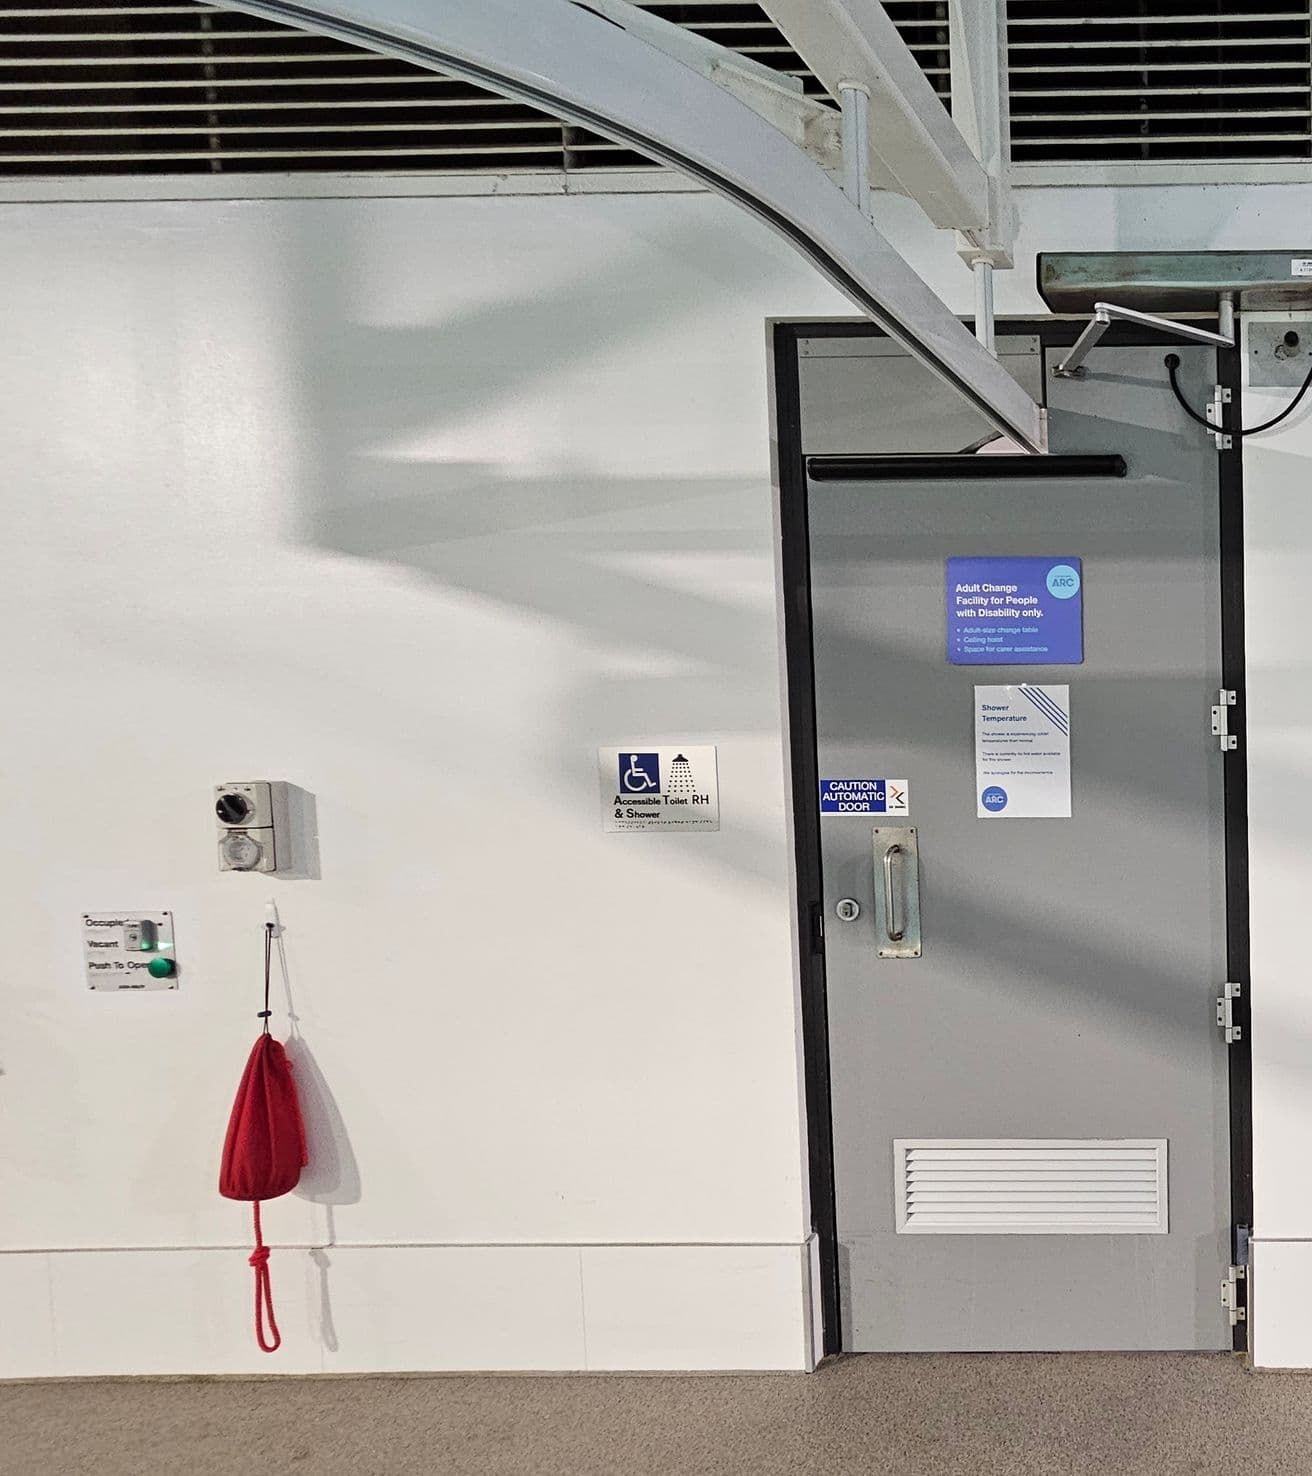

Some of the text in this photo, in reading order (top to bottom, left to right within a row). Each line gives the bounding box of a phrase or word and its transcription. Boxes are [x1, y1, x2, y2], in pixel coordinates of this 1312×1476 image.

[1052, 578, 1074, 587] ARC
[956, 583, 1018, 594] Adult Change
[956, 597, 989, 606] Facility
[1006, 596, 1038, 606] People
[956, 609, 1044, 618] with Disability only.
[829, 781, 877, 791] CAUTION
[613, 794, 709, 806] Accessible Toilet RH
[822, 791, 885, 801] AUTOMATIC
[838, 802, 870, 811] DOOR
[614, 808, 661, 819] & Shower
[86, 919, 129, 928] Occupie
[87, 940, 119, 948] Vacant
[88, 961, 150, 970] Push To Ope
